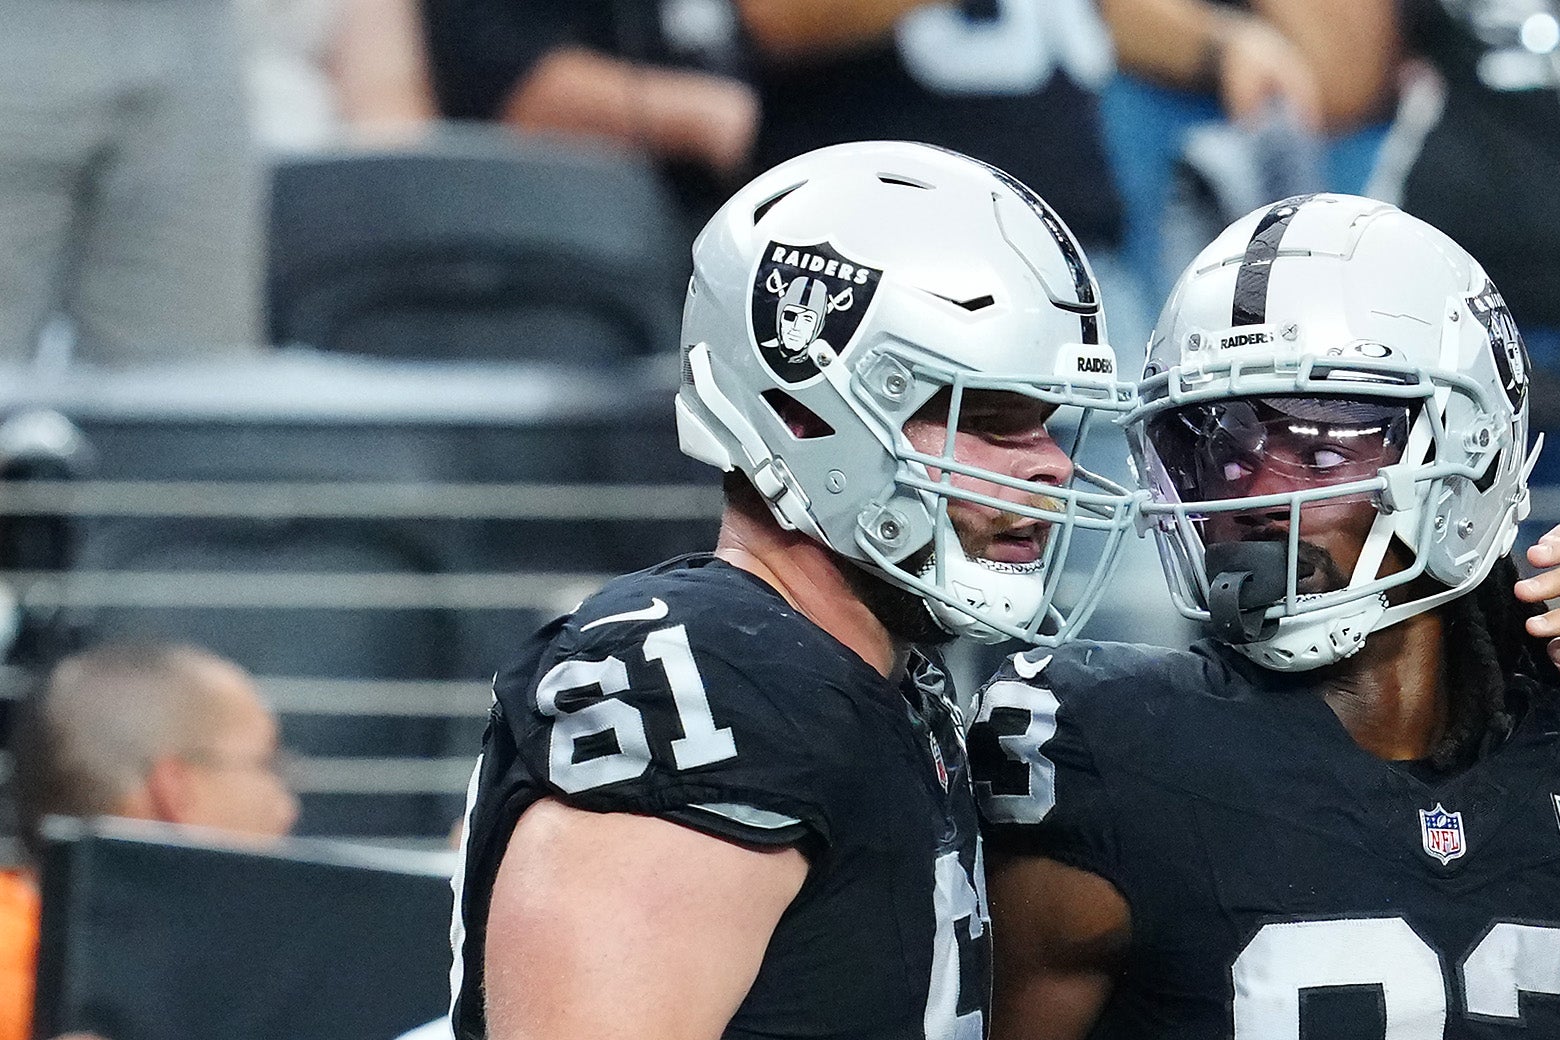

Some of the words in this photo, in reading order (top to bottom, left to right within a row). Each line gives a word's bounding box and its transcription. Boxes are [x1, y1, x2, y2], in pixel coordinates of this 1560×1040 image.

[771, 246, 870, 285] RAIDERS
[536, 624, 738, 795] 61
[967, 680, 1062, 824] 3
[1430, 829, 1459, 853] NFL
